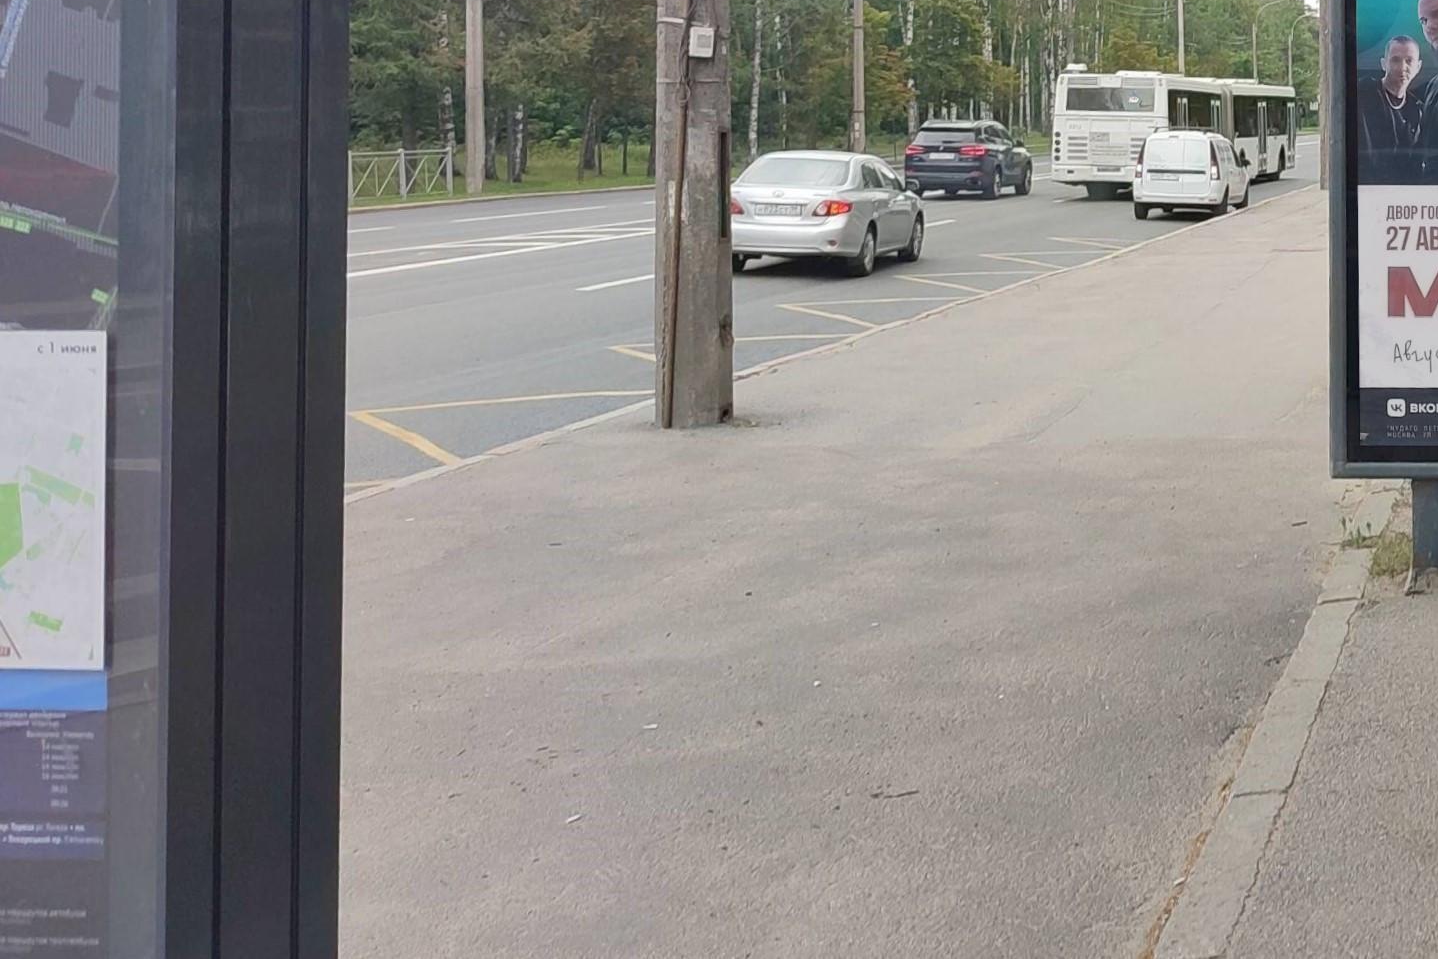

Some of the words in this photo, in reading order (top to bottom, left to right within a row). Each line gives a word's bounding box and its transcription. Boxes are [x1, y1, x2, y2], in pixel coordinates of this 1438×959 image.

[1386, 205, 1419, 222] ДВОР
[1386, 227, 1412, 252] 27
[61, 344, 97, 354] июня
